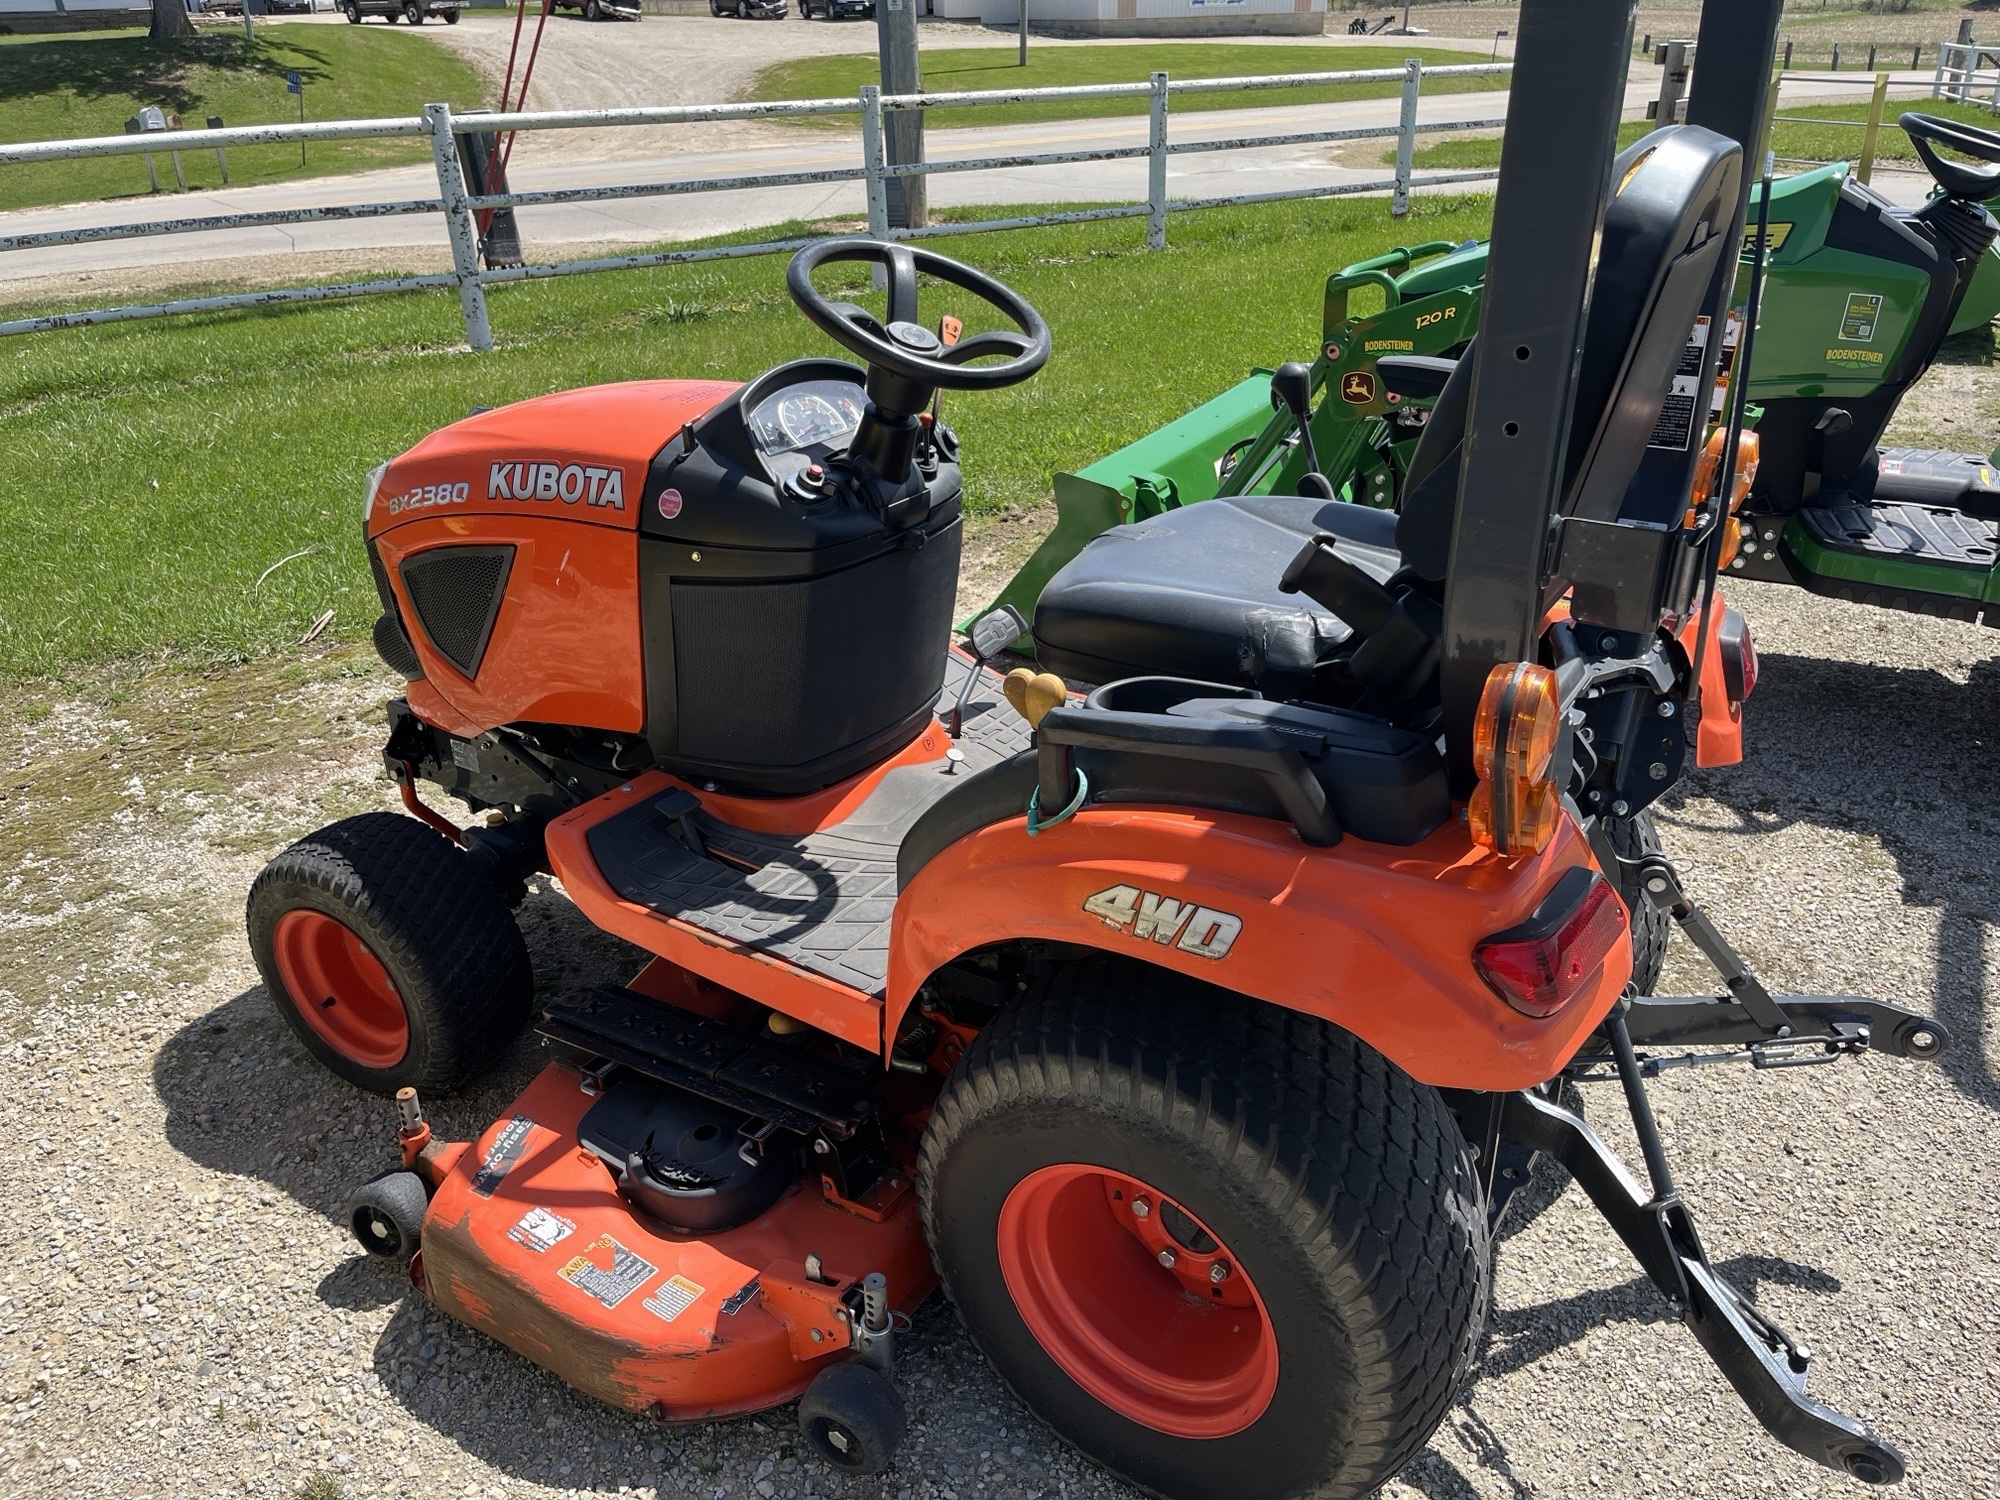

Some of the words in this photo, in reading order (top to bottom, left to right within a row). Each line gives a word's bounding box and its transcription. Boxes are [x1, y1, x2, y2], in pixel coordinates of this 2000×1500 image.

[1416, 311, 1442, 330] 120
[1444, 306, 1456, 320] R
[1364, 340, 1414, 352] BODENSTEINER
[1826, 349, 1883, 363] BODENSTEINER
[389, 482, 469, 516] BX2380
[487, 462, 625, 510] KUBOTA
[1082, 883, 1243, 960] 4WD
